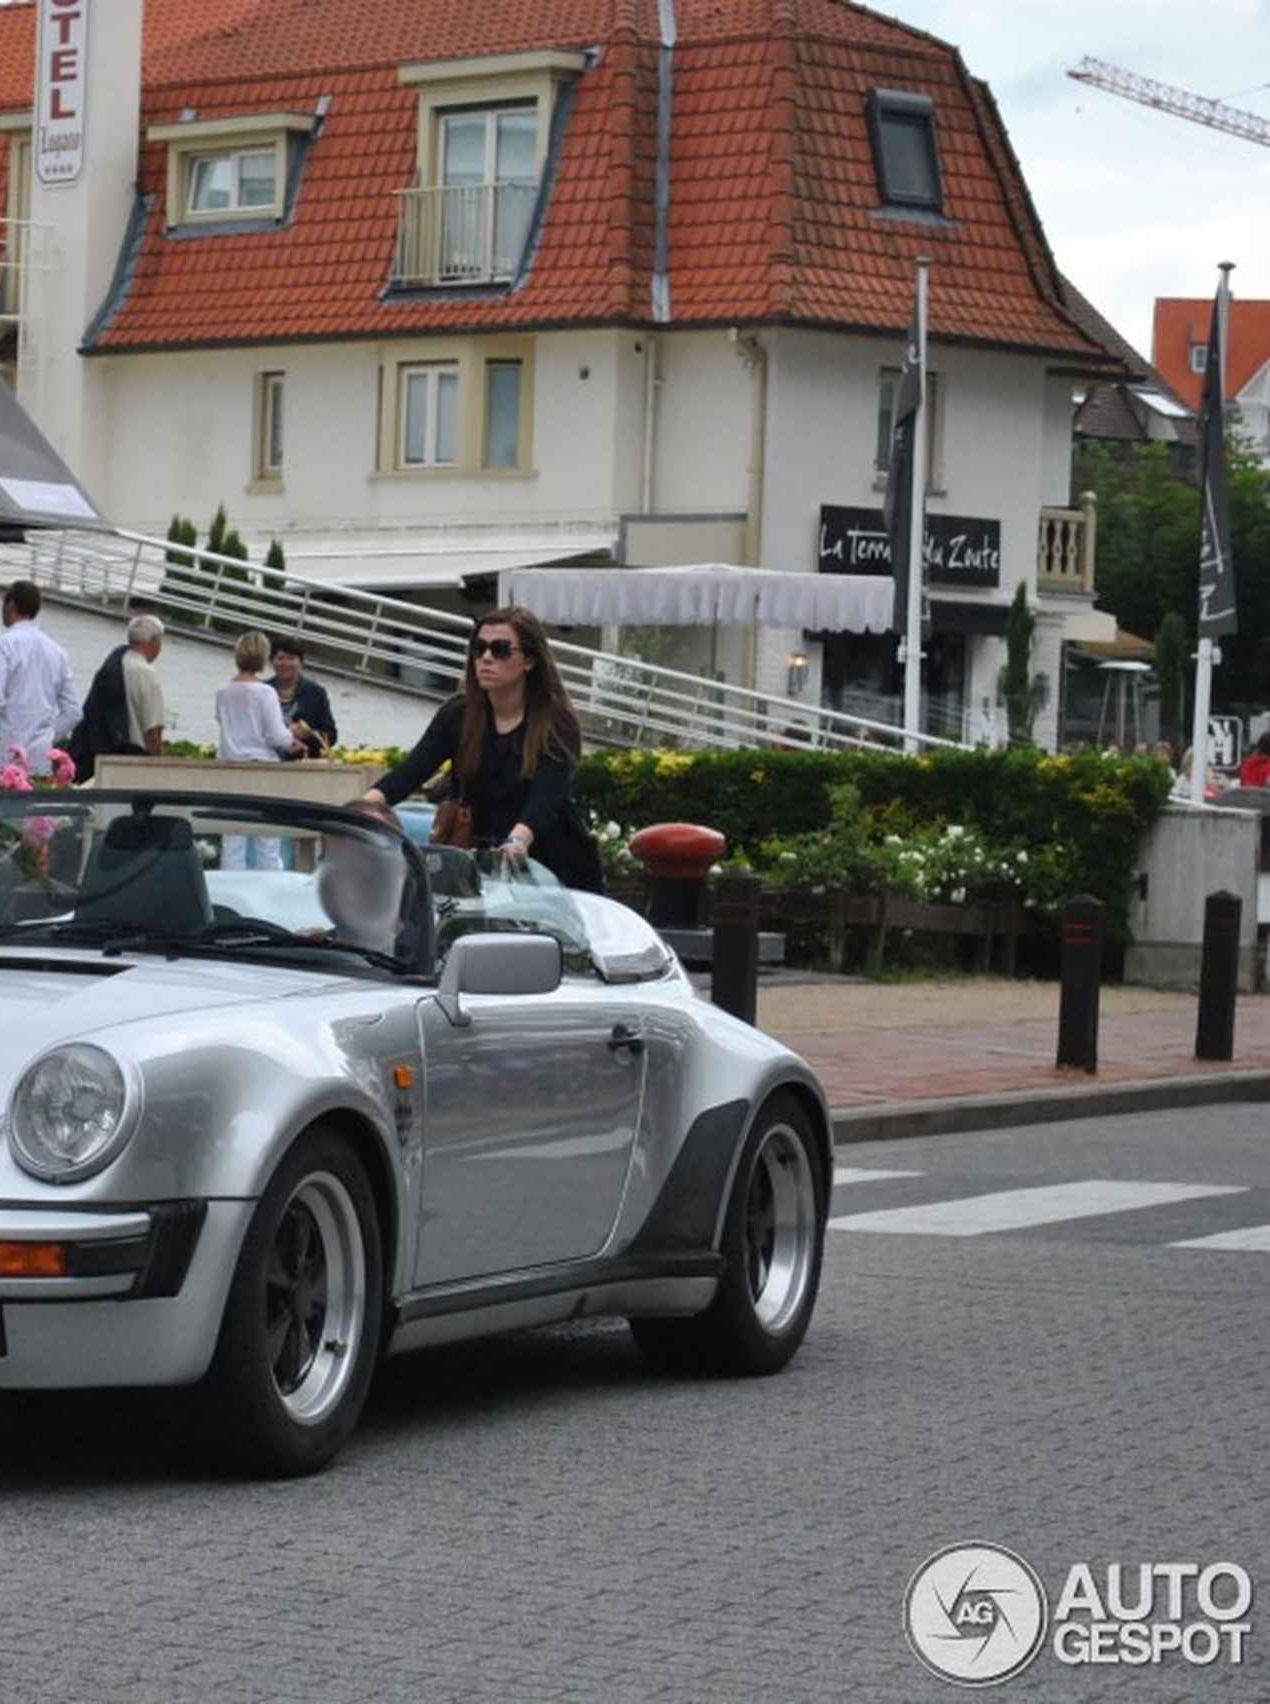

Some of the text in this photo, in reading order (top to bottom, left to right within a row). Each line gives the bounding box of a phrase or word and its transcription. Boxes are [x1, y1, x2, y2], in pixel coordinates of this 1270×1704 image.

[50, 0, 80, 120] TEL
[820, 523, 842, 560] La
[846, 523, 892, 564] Terra
[947, 534, 1000, 570] Zoute
